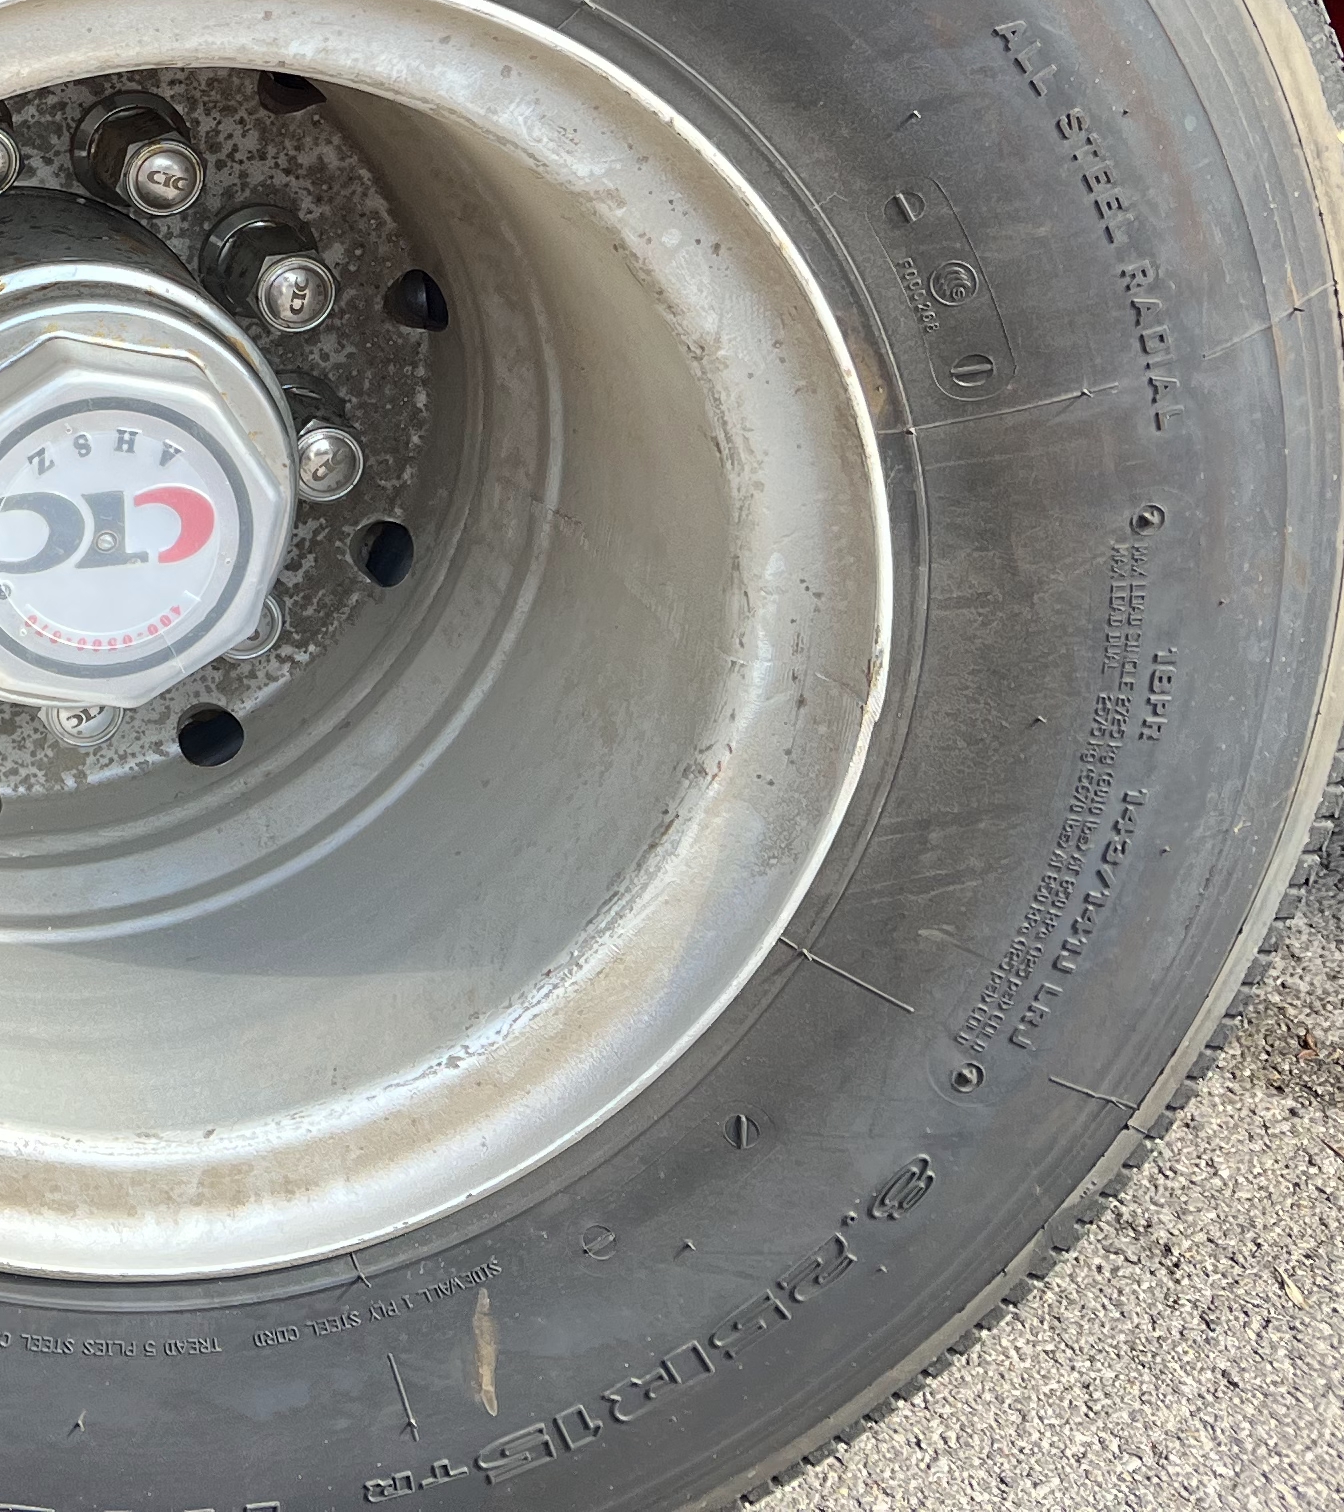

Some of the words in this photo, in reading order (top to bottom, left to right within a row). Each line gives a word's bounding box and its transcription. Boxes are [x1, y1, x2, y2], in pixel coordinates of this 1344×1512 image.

[992, 19, 1058, 98] ALL
[1054, 107, 1136, 244] STEEL
[1119, 260, 1187, 432] RADIAL
[27, 428, 185, 476] AHSZ
[1136, 645, 1180, 743] 18PR
[1049, 786, 1149, 978] 143/141J
[1004, 980, 1066, 1053] LRJ
[417, 1253, 504, 1308] SIDEWALL
[366, 1296, 400, 1323] PLY
[399, 1292, 414, 1312] 1
[251, 1324, 300, 1349] CORD
[305, 1308, 362, 1339] STEEL
[16, 1330, 75, 1356] STEEL
[80, 1338, 138, 1359] PLIES
[142, 1339, 157, 1357] 5
[163, 1334, 221, 1357] TREAD
